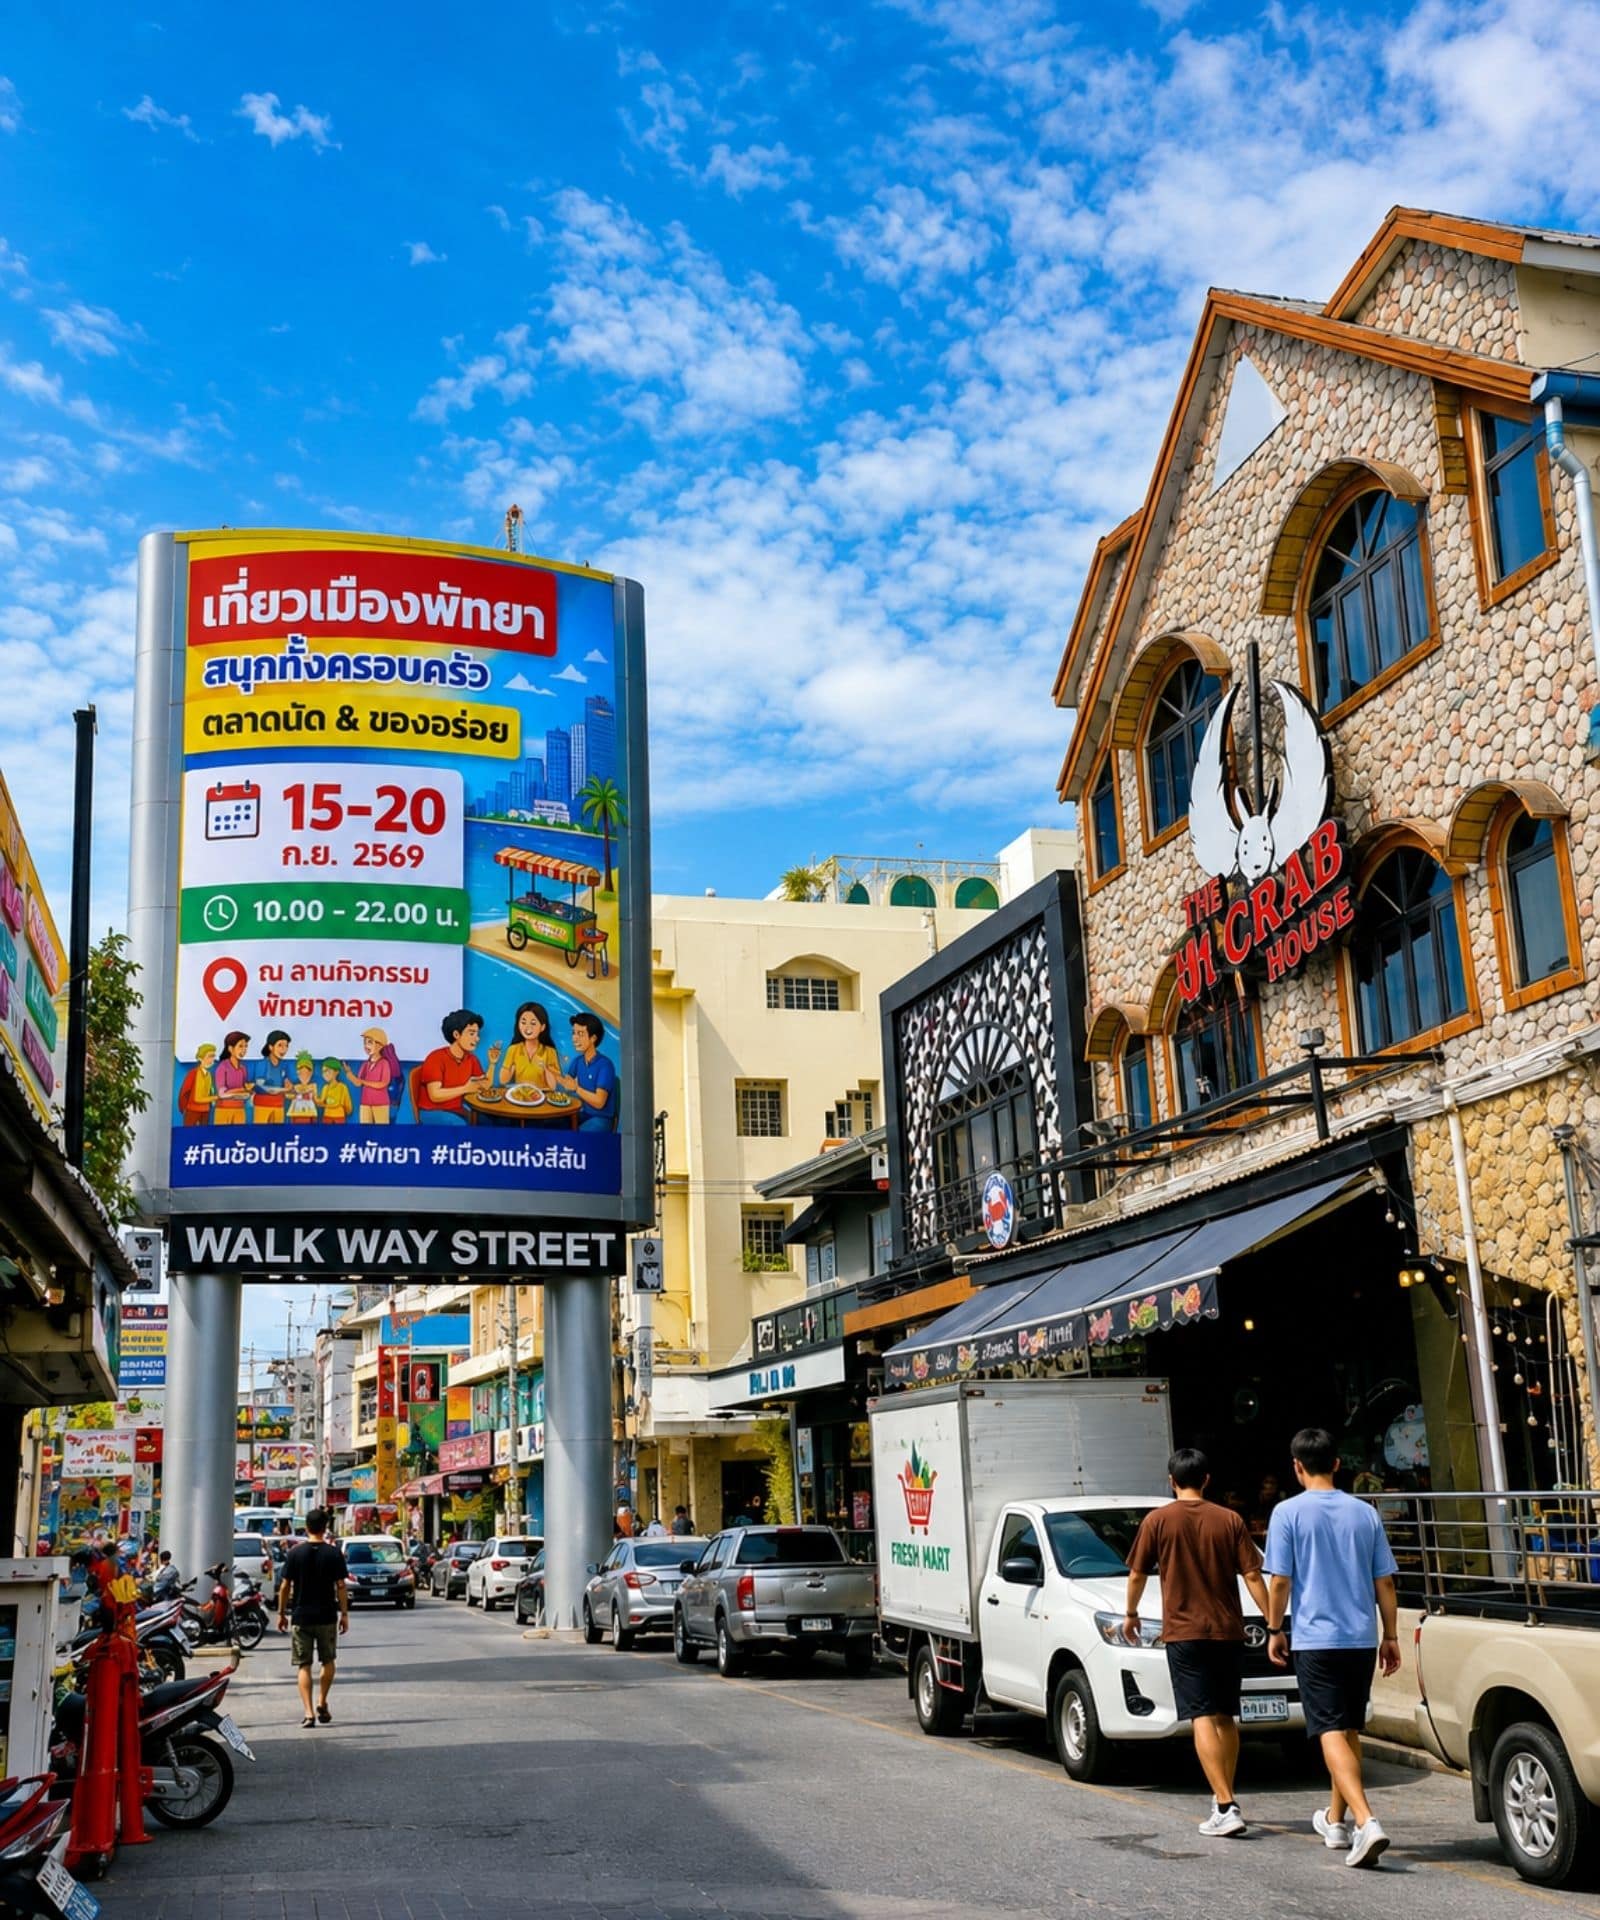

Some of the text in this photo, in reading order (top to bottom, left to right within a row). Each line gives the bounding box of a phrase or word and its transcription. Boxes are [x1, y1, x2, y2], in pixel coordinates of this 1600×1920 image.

[203, 567, 545, 640] เที่ยวเมืองพัทยา
[204, 634, 490, 693] สนุกทั้งครอบครัว
[203, 702, 508, 743] ตลาดนัด & ของอร่อย
[282, 843, 425, 868] ก.ย. 2569
[1181, 877, 1222, 929] THE
[1224, 819, 1343, 965] CRAB
[253, 900, 324, 922] 10.00
[355, 901, 428, 924] 22.00
[436, 908, 460, 927] น.
[1265, 886, 1354, 983] HOUSE
[259, 960, 429, 984] ณ ลานกิจกรรม
[258, 992, 393, 1018] พัทยากลาง
[184, 1134, 587, 1170] #กินช้อปเที่ยว #พัทยา #เมืองแห่งสีสัน
[185, 1227, 616, 1267] WALK WAY STREET
[891, 1542, 950, 1572] FRESH MART
